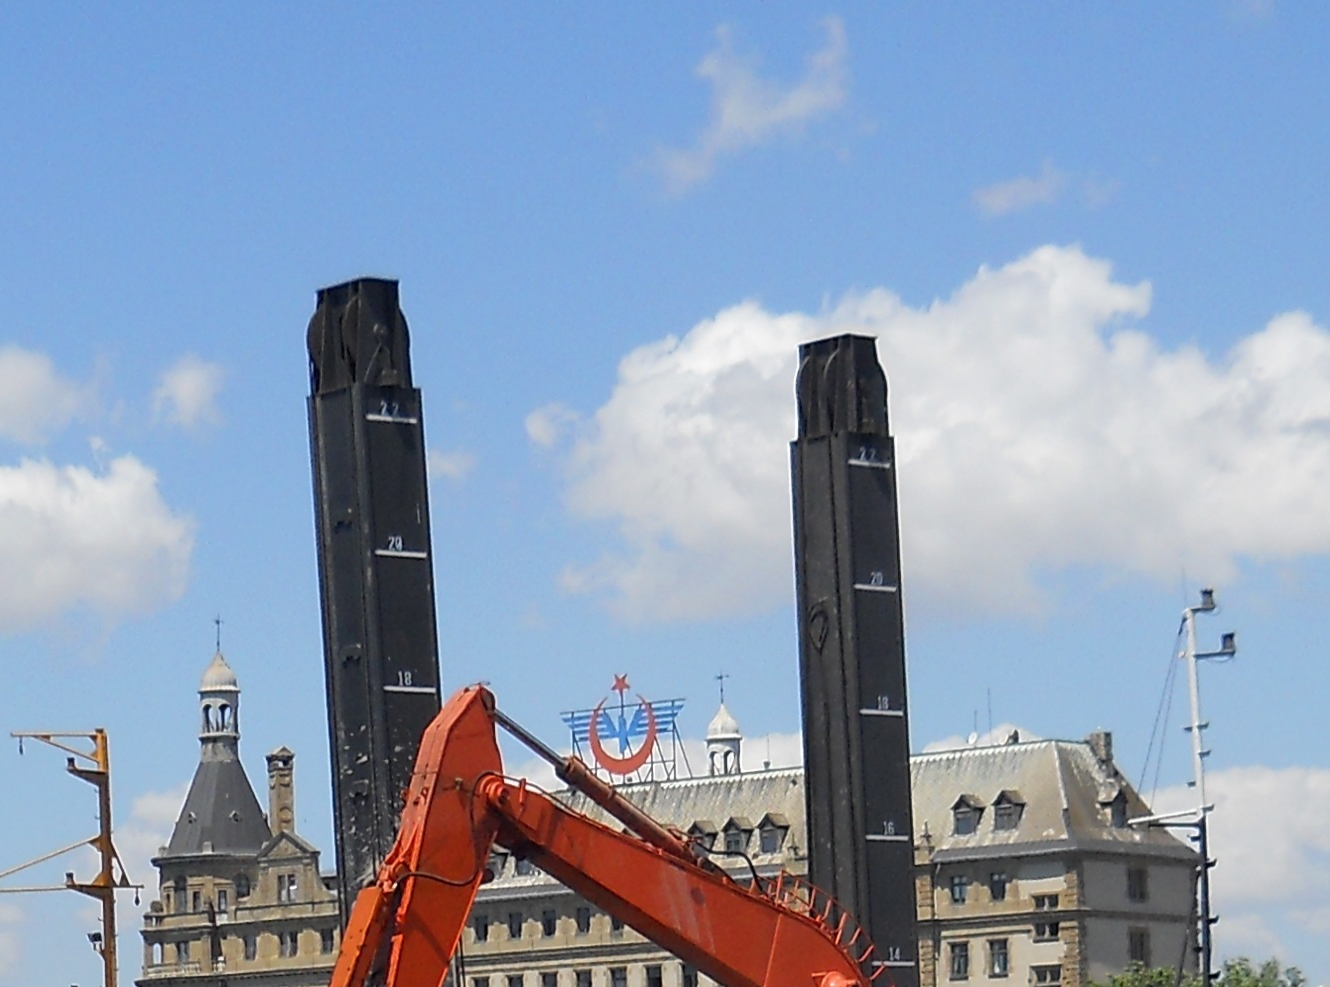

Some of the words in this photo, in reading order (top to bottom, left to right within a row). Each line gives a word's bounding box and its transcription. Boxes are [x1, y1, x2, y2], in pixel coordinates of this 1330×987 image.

[388, 536, 403, 551] 20
[870, 571, 883, 585] 20
[398, 670, 412, 686] 18
[883, 821, 895, 835] 16
[889, 946, 901, 960] 14
